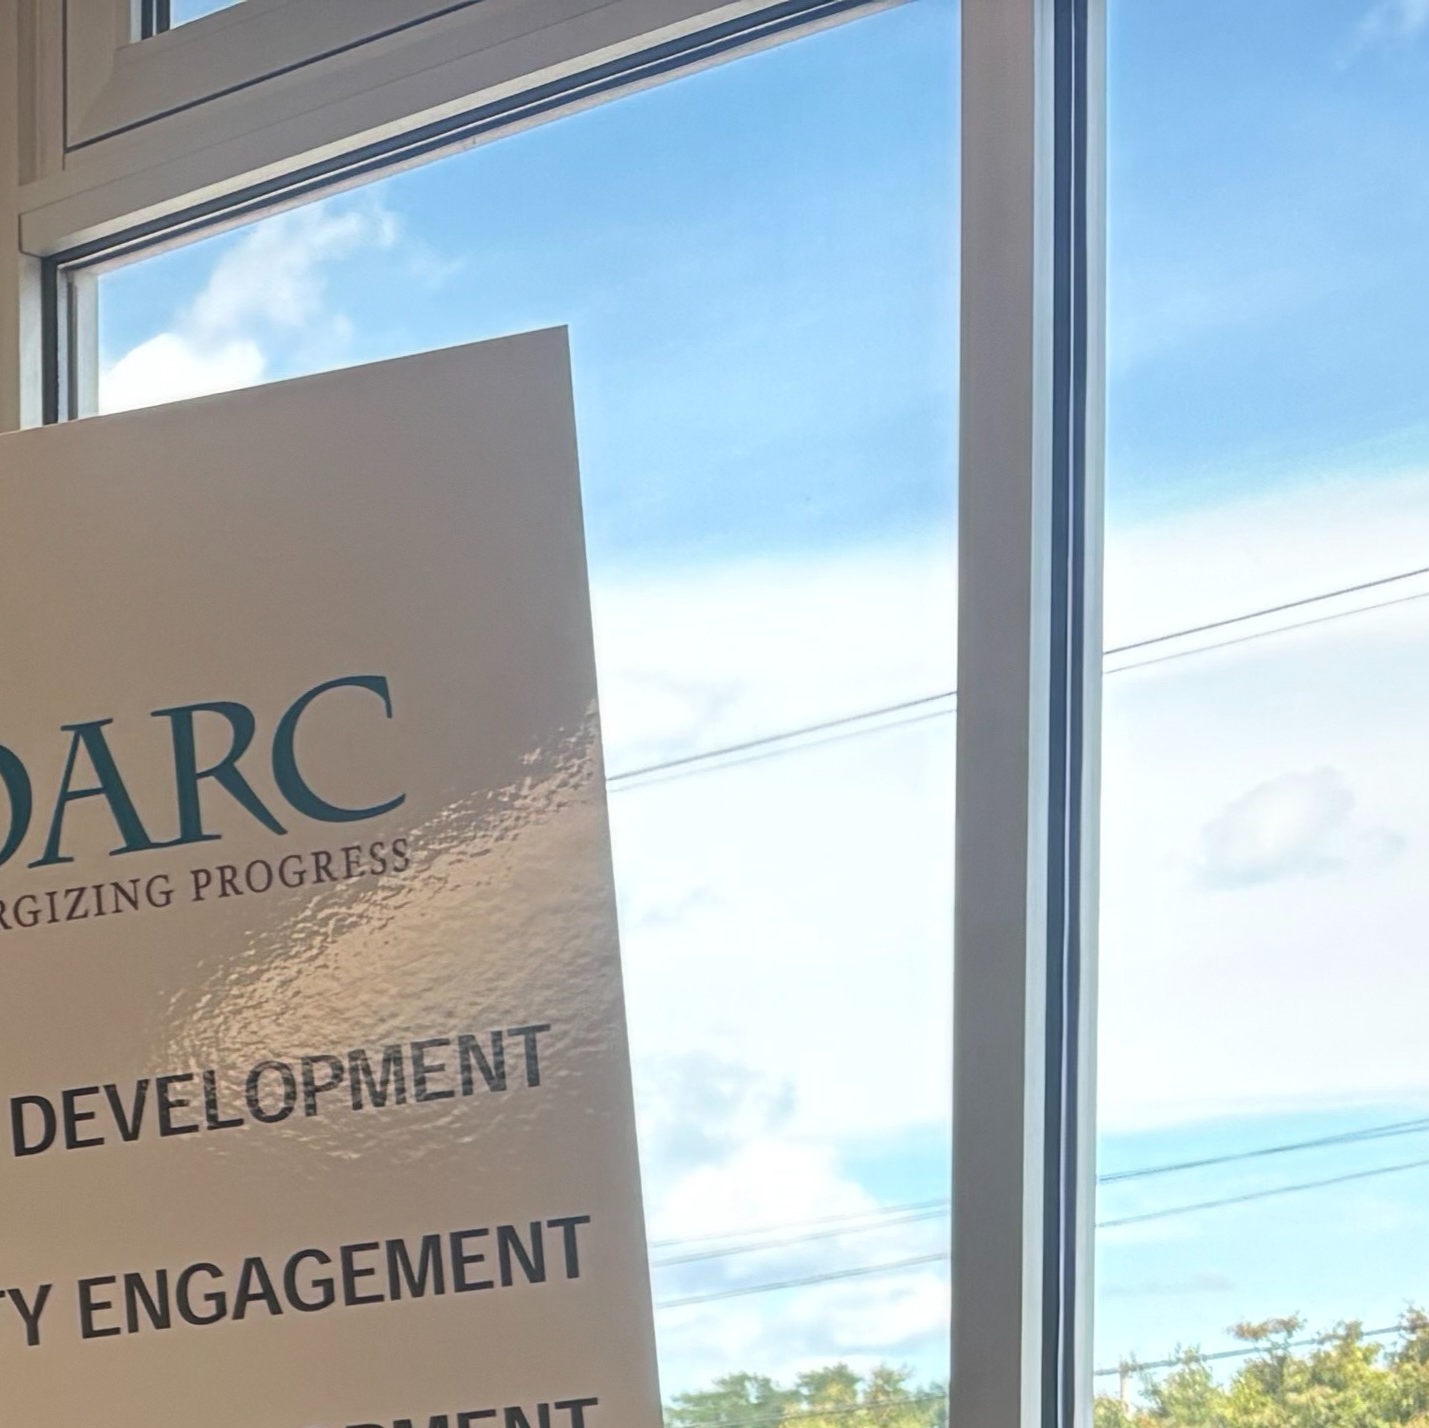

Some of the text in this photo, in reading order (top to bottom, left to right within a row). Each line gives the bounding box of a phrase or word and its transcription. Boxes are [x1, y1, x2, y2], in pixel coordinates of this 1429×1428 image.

[190, 838, 411, 901] PROGRESS
[10, 1023, 551, 1157] DEVELOPMENT
[78, 1214, 591, 1339] ENGAGEMENT
